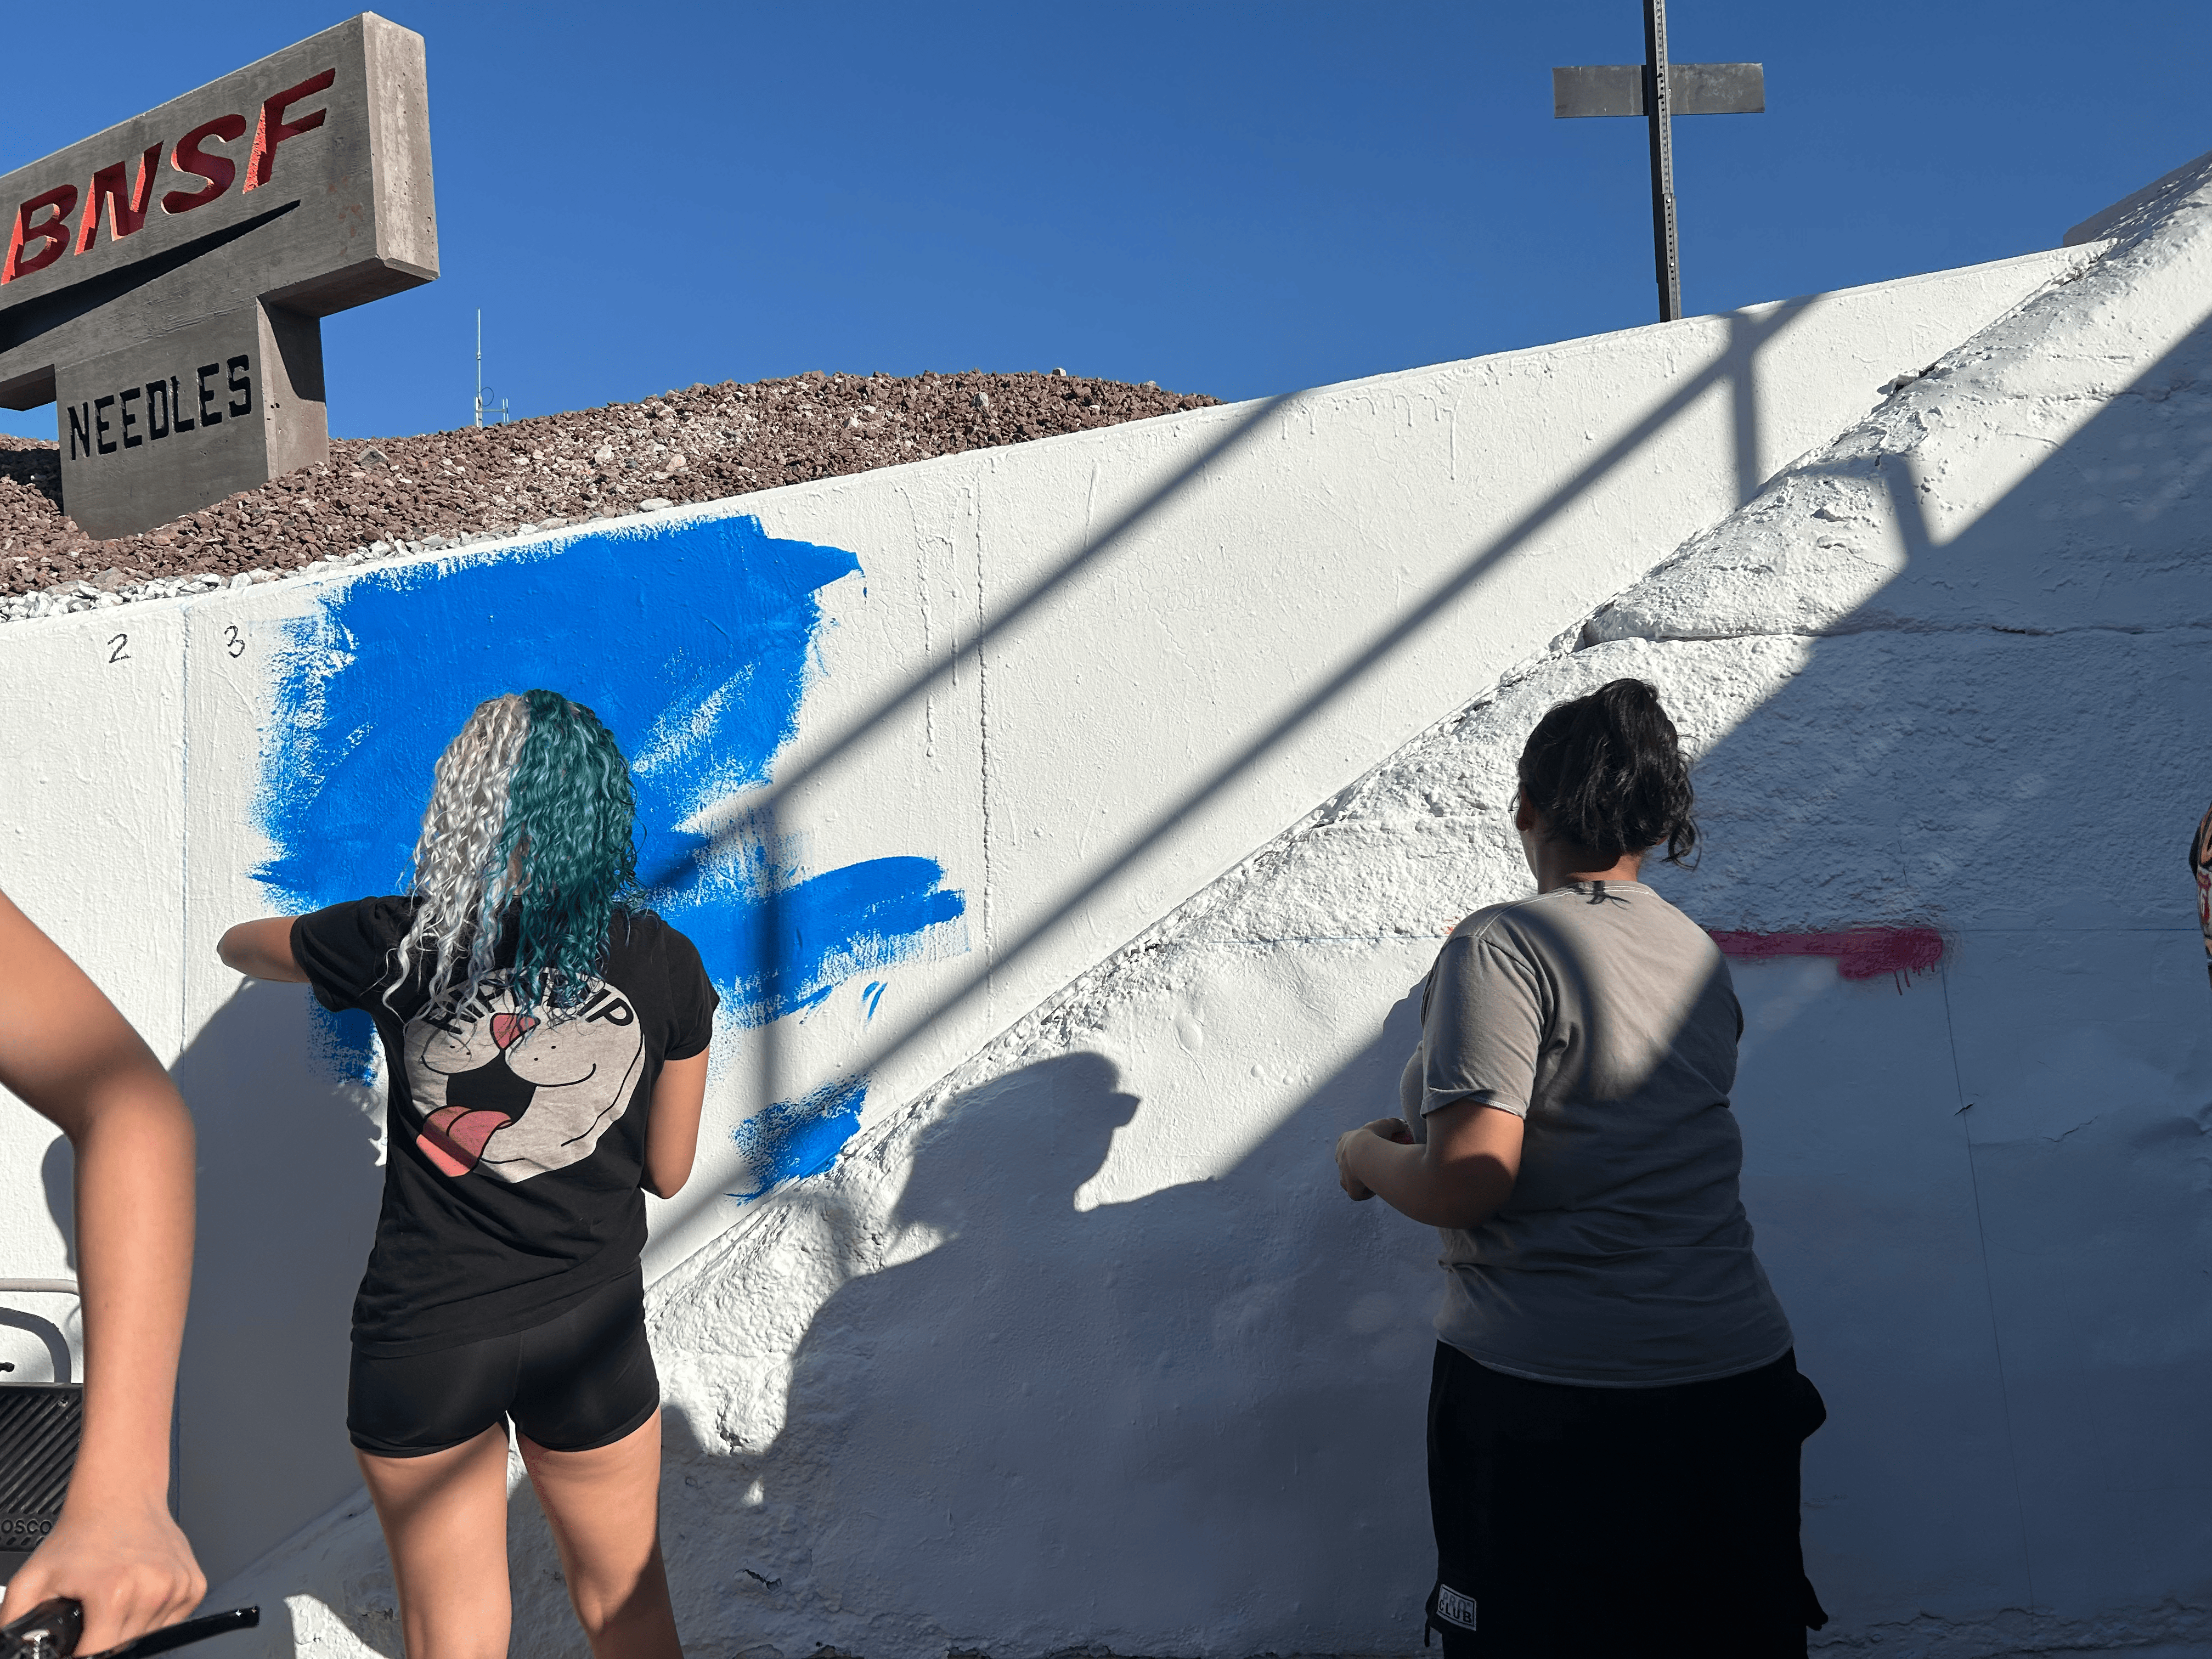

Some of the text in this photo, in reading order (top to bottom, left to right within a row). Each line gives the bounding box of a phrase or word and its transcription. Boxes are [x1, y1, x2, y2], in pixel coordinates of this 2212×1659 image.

[2, 67, 335, 285] BNSF
[67, 354, 252, 461] NEEDLES
[107, 633, 132, 664] 2
[224, 625, 245, 658] 3
[1440, 1599, 1471, 1623] CLUB
